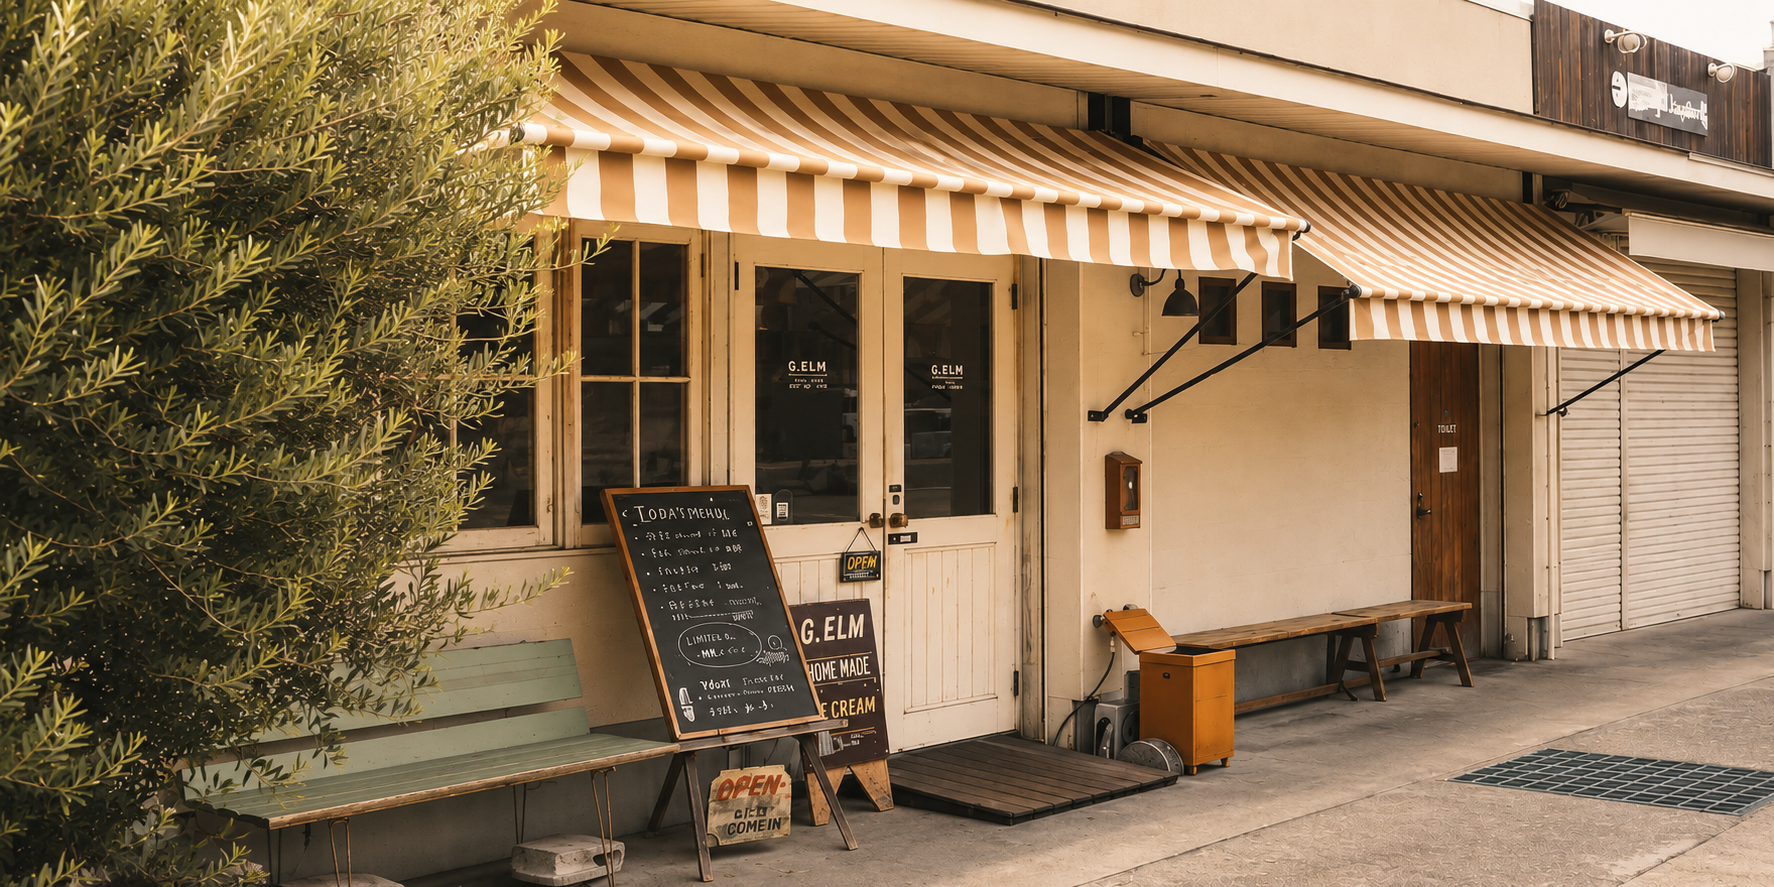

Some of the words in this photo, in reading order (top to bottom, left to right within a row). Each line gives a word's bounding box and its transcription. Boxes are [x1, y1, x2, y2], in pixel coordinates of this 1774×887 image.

[788, 360, 826, 372] G.ELM
[931, 364, 963, 375] G.ELM
[800, 613, 865, 645] G.ELM
[839, 656, 871, 678] MADE
[831, 695, 876, 719] CREAM
